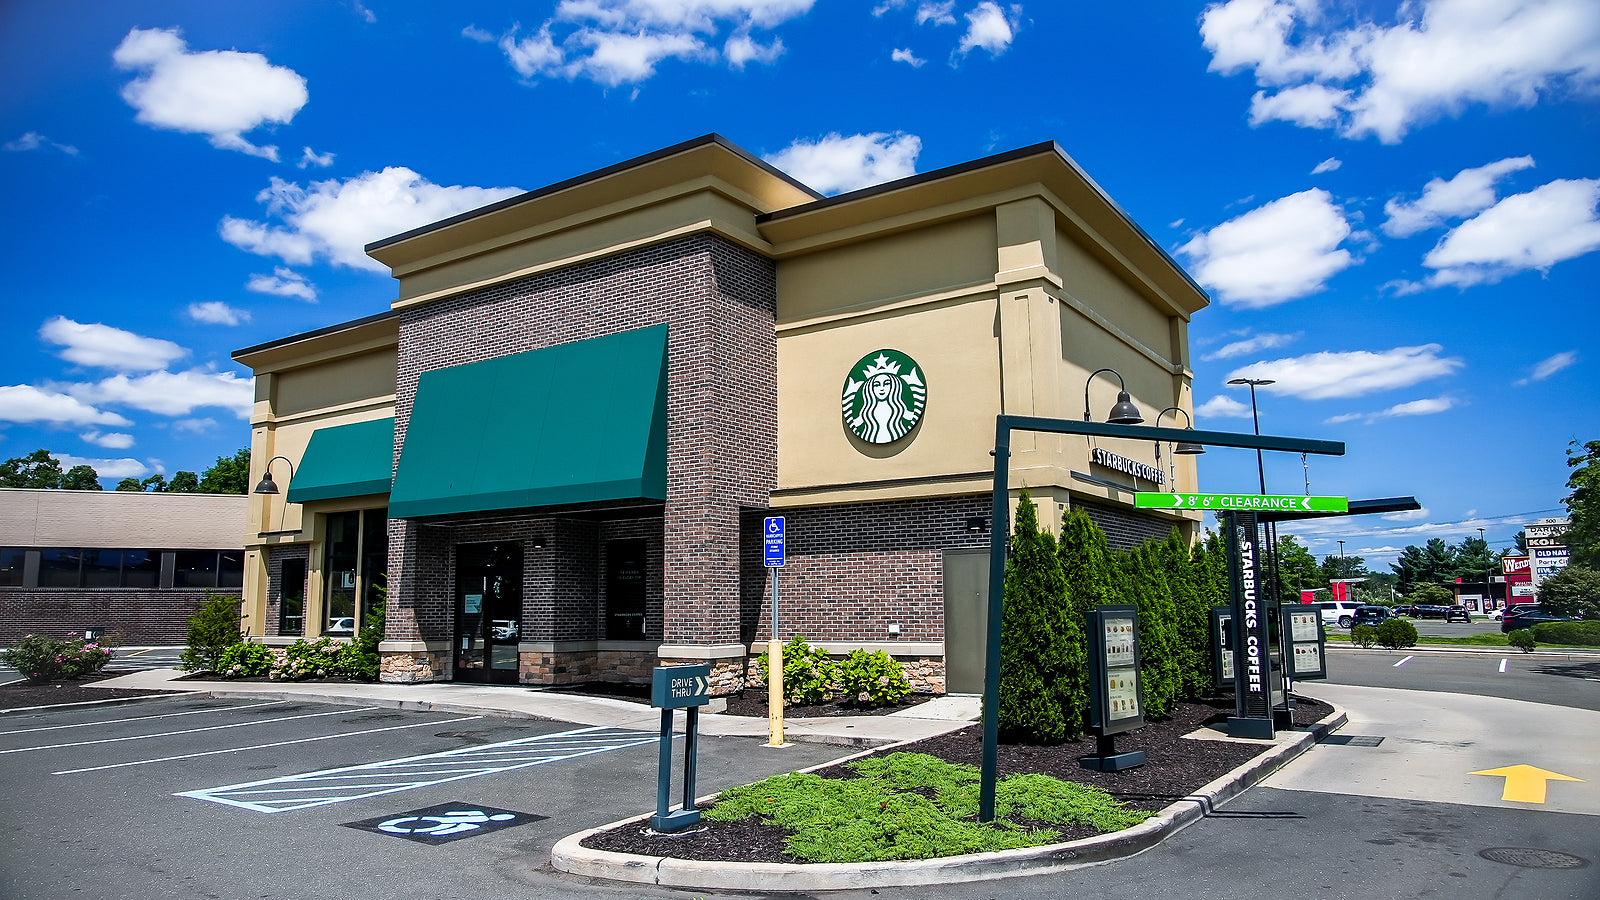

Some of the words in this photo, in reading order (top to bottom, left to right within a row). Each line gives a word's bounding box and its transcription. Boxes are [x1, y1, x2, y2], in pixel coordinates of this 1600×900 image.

[1096, 448, 1142, 478] STARBUCKS
[1142, 464, 1166, 485] COFFEE
[1220, 496, 1297, 508] CLEARANCE
[1241, 541, 1258, 629] STARBUCKS
[1247, 635, 1261, 692] COFFEE
[671, 677, 693, 688] DRIVE
[671, 688, 692, 698] THRU
